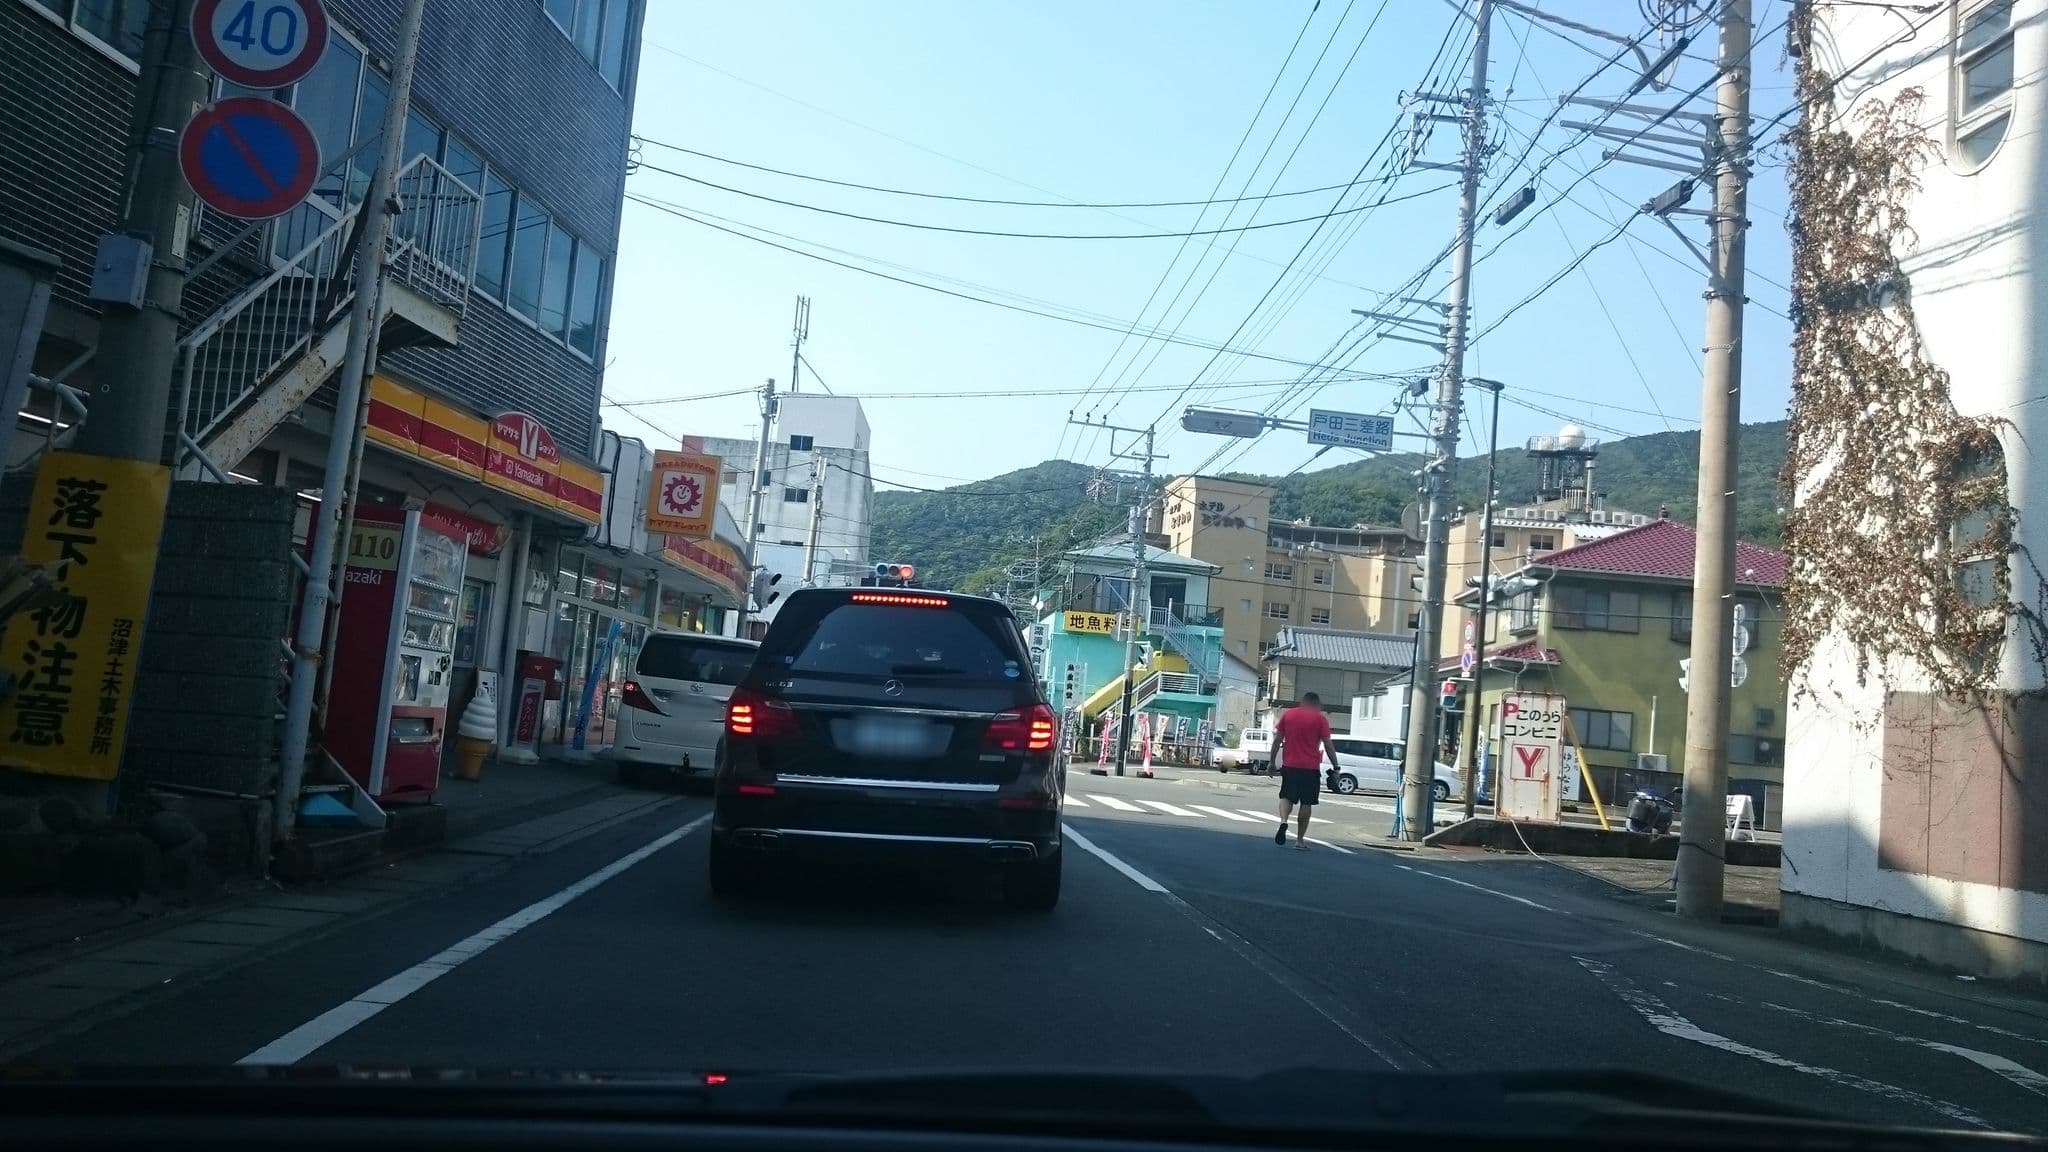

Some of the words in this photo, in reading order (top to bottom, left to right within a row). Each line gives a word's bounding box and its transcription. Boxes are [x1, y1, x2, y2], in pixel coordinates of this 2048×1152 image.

[222, 0, 298, 56] 40
[524, 419, 538, 455] Y
[1312, 414, 1390, 435] 戸田三差路
[1312, 431, 1340, 442] Heda
[1343, 433, 1388, 446] Junction
[496, 423, 519, 441] ヤマザキ
[538, 441, 560, 463] ショップ
[514, 462, 544, 487] Yamazaki
[1199, 500, 1225, 512] ホテル
[9, 476, 109, 746] 落下物注意
[90, 618, 133, 756] 沼津土木事務所
[1516, 708, 1561, 723] このうら
[1503, 724, 1557, 740] コンビニ
[1515, 746, 1545, 778] Y
